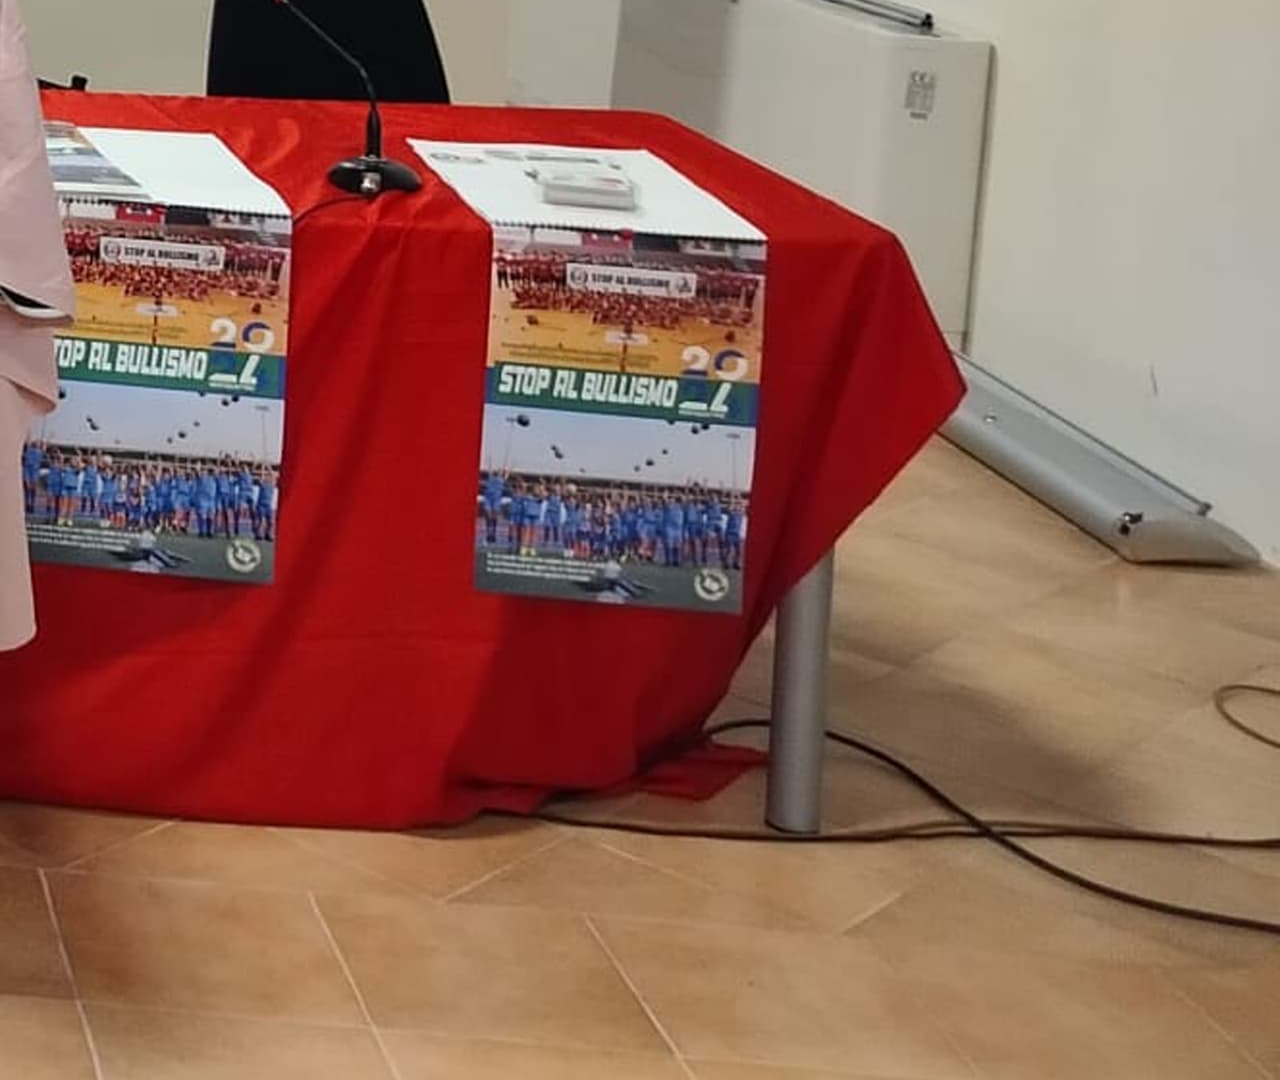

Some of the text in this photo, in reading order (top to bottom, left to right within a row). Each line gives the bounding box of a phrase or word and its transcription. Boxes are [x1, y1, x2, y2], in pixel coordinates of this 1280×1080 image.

[54, 338, 209, 381] TOP AL BULLISMO
[498, 365, 679, 408] STOP AL BULLISMO
